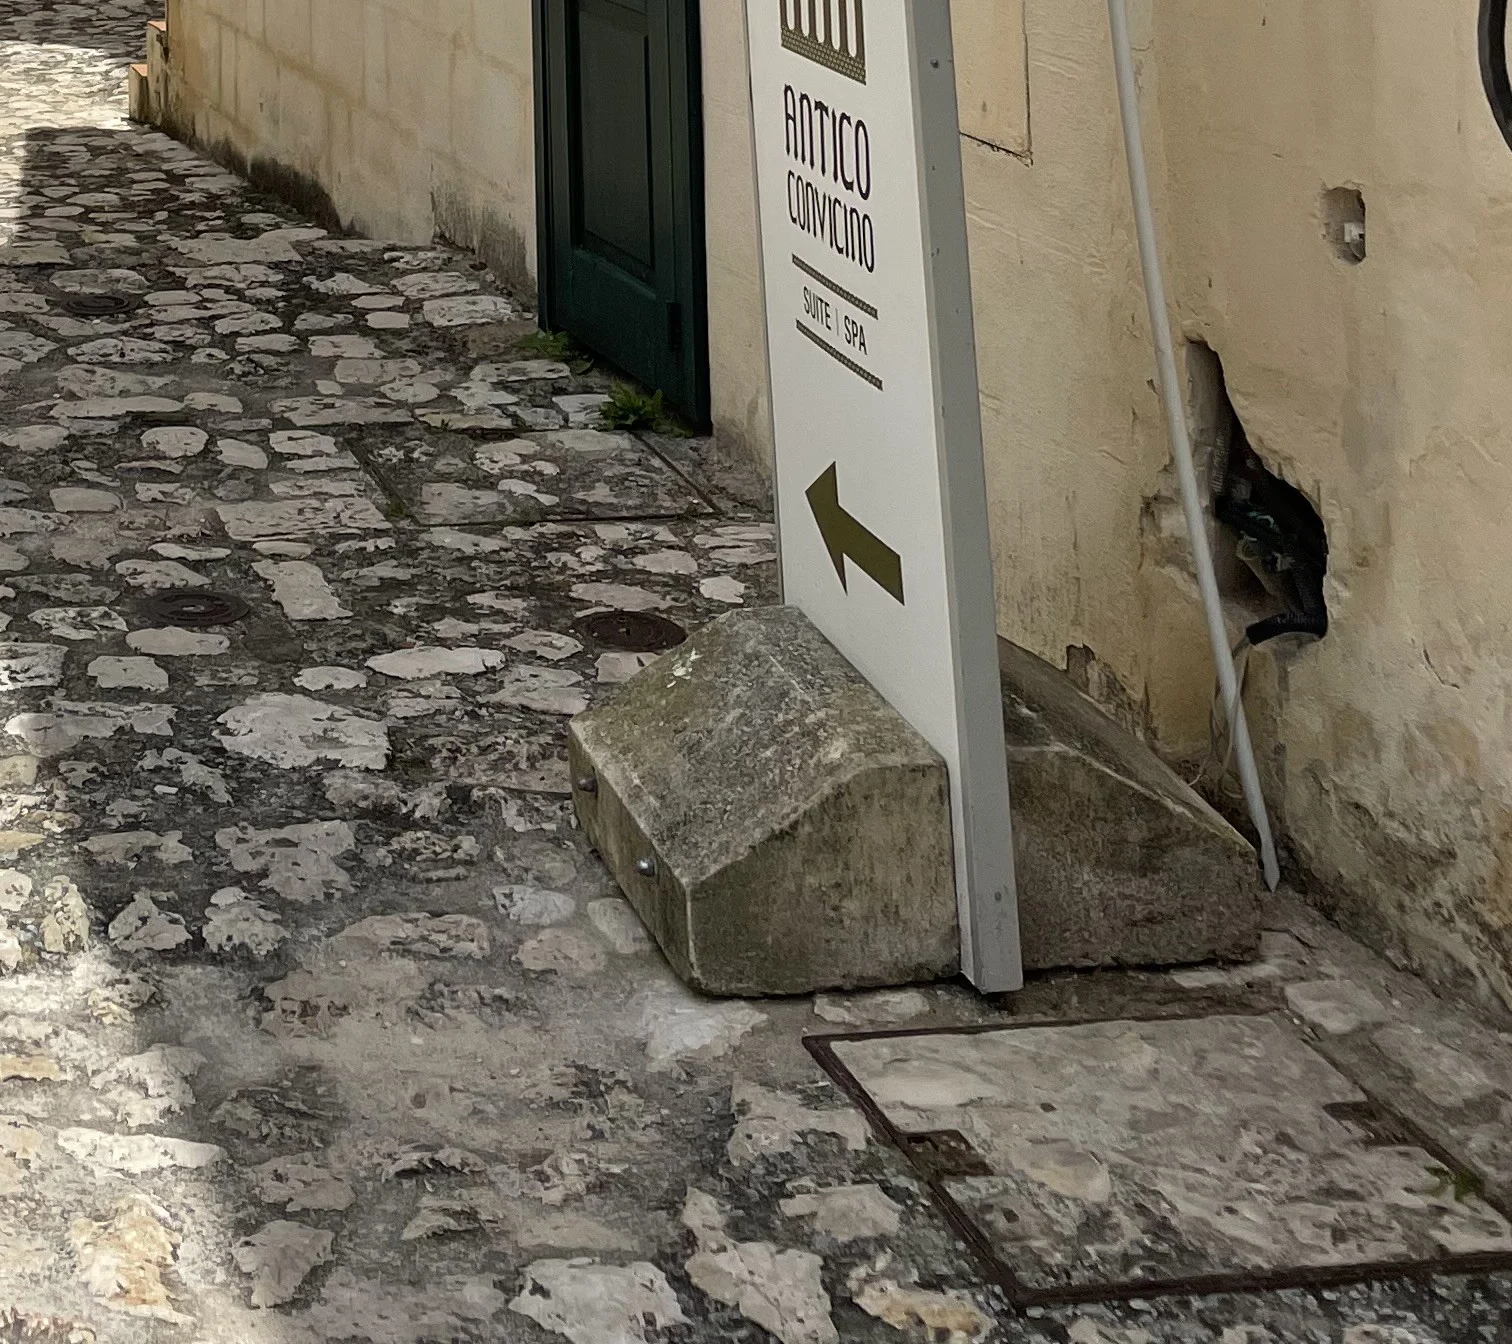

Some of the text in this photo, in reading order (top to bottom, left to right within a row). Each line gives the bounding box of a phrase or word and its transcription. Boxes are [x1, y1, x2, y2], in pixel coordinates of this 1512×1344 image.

[783, 83, 872, 201] ANTICO
[787, 169, 875, 274] CONVICINO
[803, 285, 868, 356] SUITE SPA
